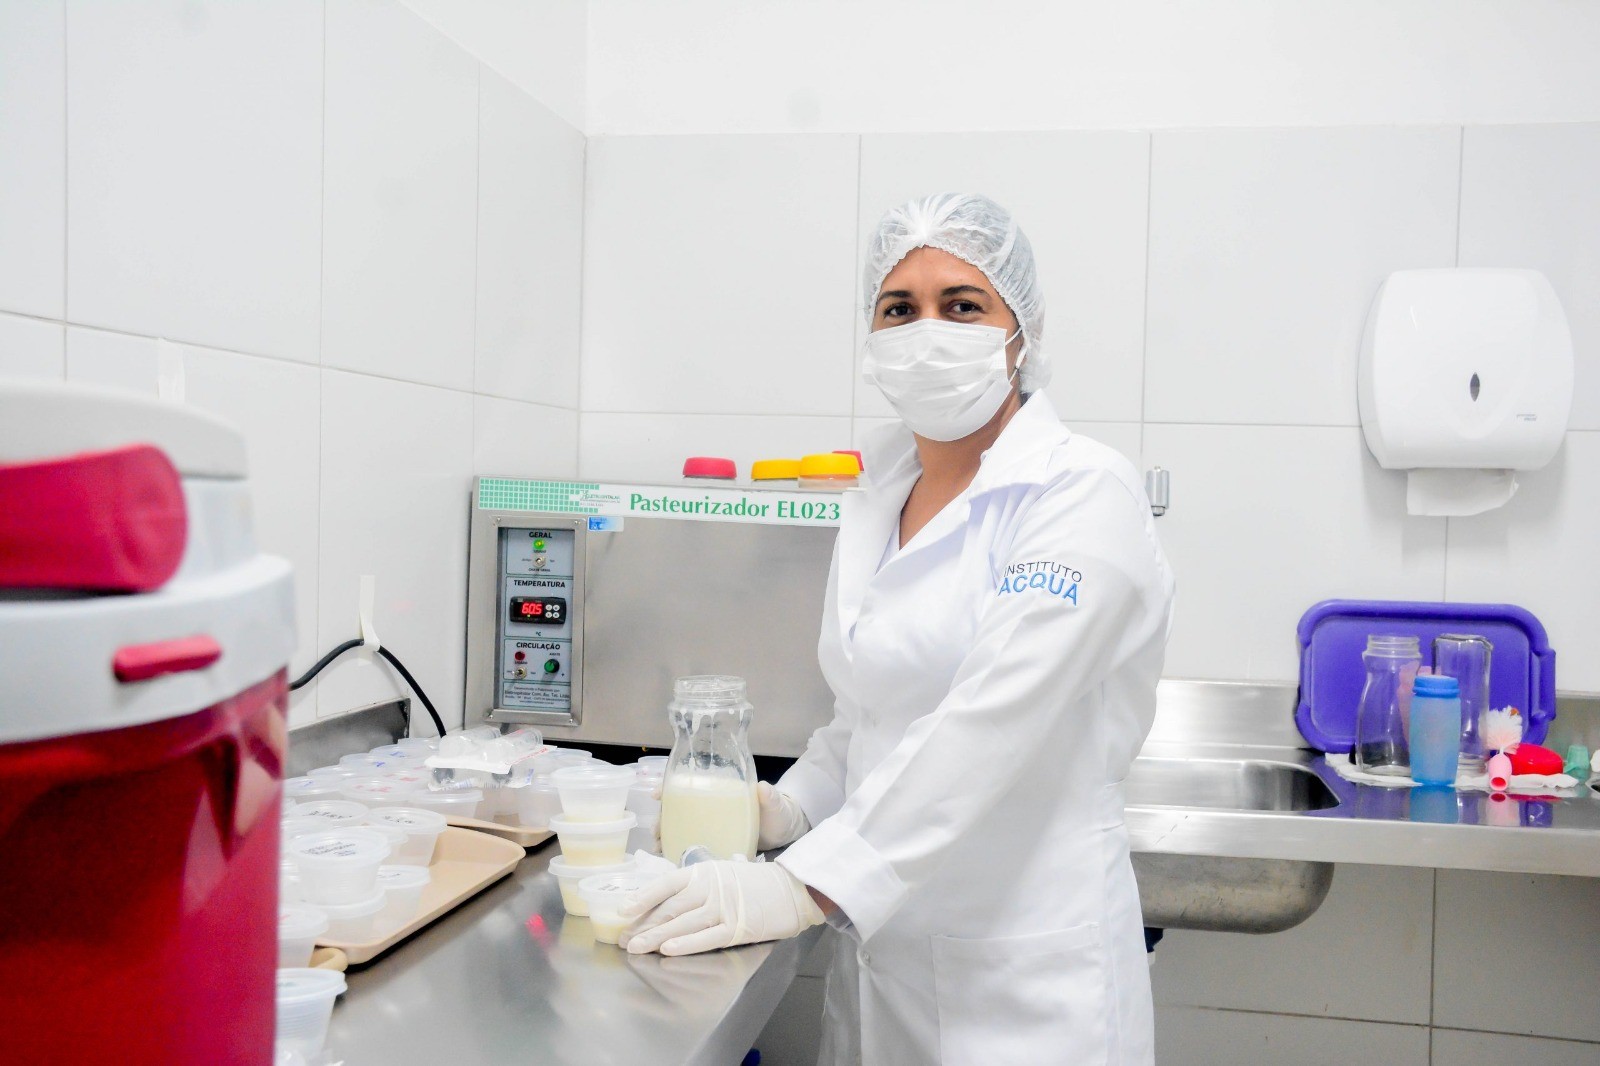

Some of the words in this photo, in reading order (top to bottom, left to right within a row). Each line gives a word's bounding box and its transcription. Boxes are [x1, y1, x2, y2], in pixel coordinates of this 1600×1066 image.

[630, 493, 770, 517] Pasteurizador
[777, 500, 840, 520] EL023
[529, 531, 552, 539] GERAL
[1003, 561, 1082, 583] INSTITUTO
[514, 579, 566, 588] TEMPERATURA
[997, 571, 1078, 606] ACQUA
[516, 642, 561, 650] CIRCULAÇÃO
